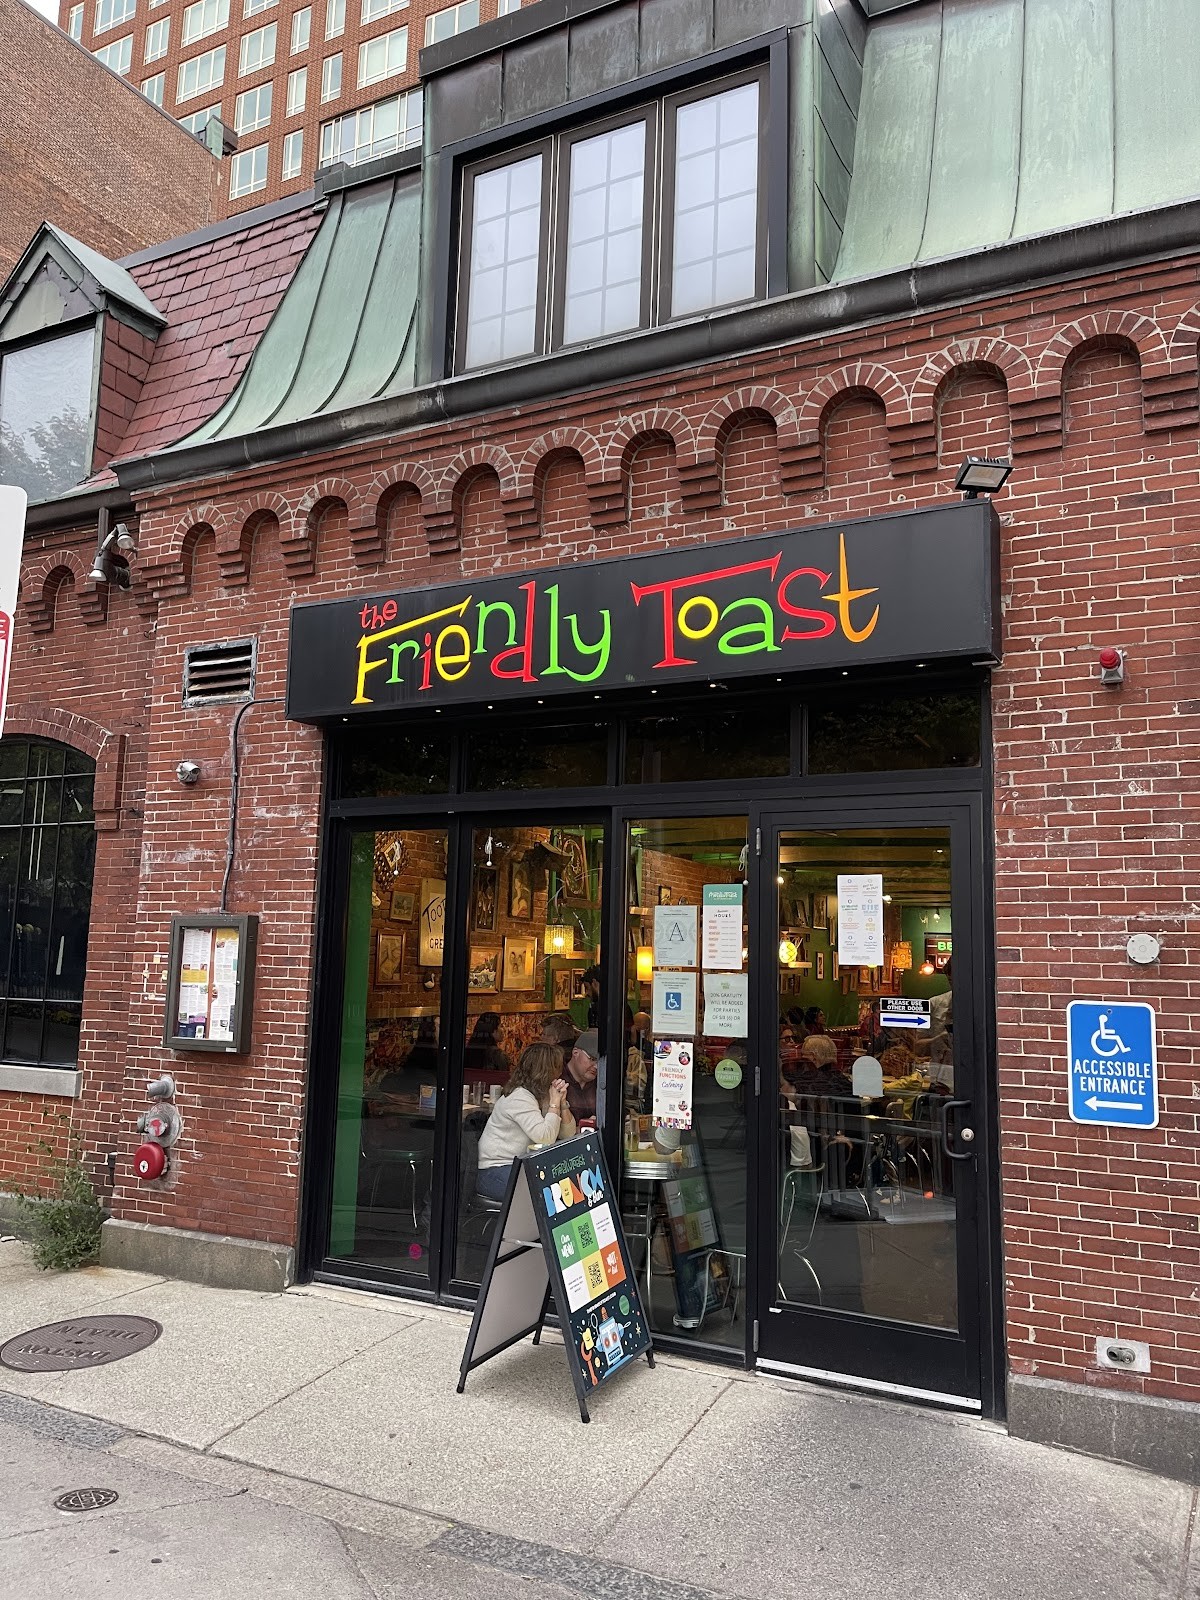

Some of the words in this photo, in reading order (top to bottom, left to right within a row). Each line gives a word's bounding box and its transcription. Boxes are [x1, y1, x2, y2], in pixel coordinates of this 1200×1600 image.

[351, 580, 612, 705] Friendly
[630, 532, 881, 669] Toast
[358, 599, 398, 630] the
[668, 922, 685, 941] A
[659, 1072, 687, 1080] FUNCTIONS
[662, 1066, 684, 1074] FRIENDLY
[1073, 1058, 1151, 1078] ACCESSIBLE
[1080, 1076, 1146, 1096] ENTRANCE
[542, 1164, 605, 1218] BRUNCH
[53, 1326, 145, 1340] DRAIN
